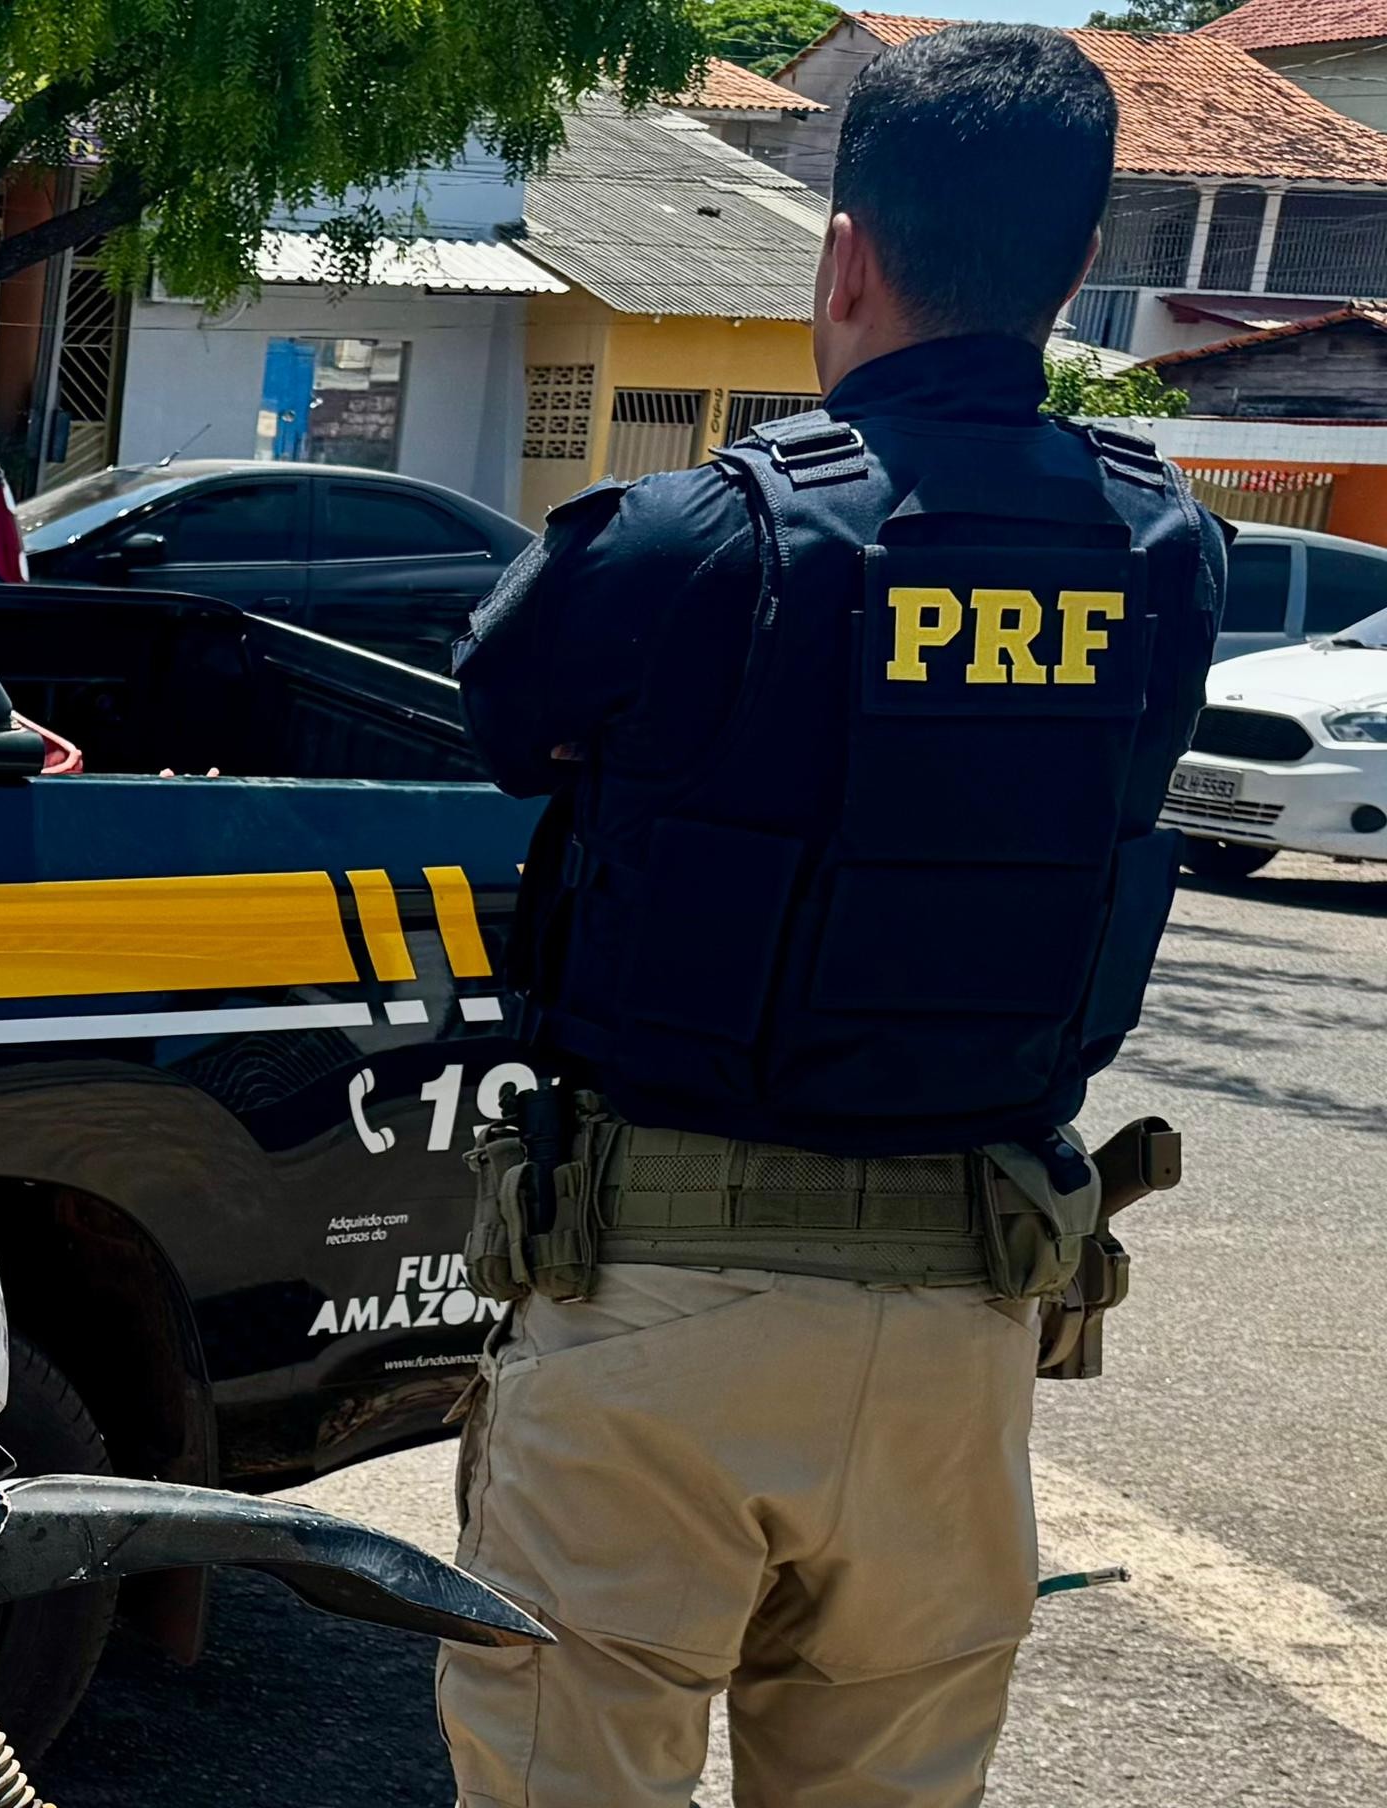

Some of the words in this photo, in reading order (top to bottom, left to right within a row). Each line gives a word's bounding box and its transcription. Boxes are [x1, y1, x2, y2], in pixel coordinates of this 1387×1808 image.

[887, 587, 1125, 684] PRF
[420, 1062, 561, 1151] 19
[326, 1231, 369, 1246] recursos
[371, 1229, 388, 1241] do
[328, 1214, 381, 1231] Adquirido
[383, 1214, 409, 1226] com
[396, 1254, 468, 1292] FUN
